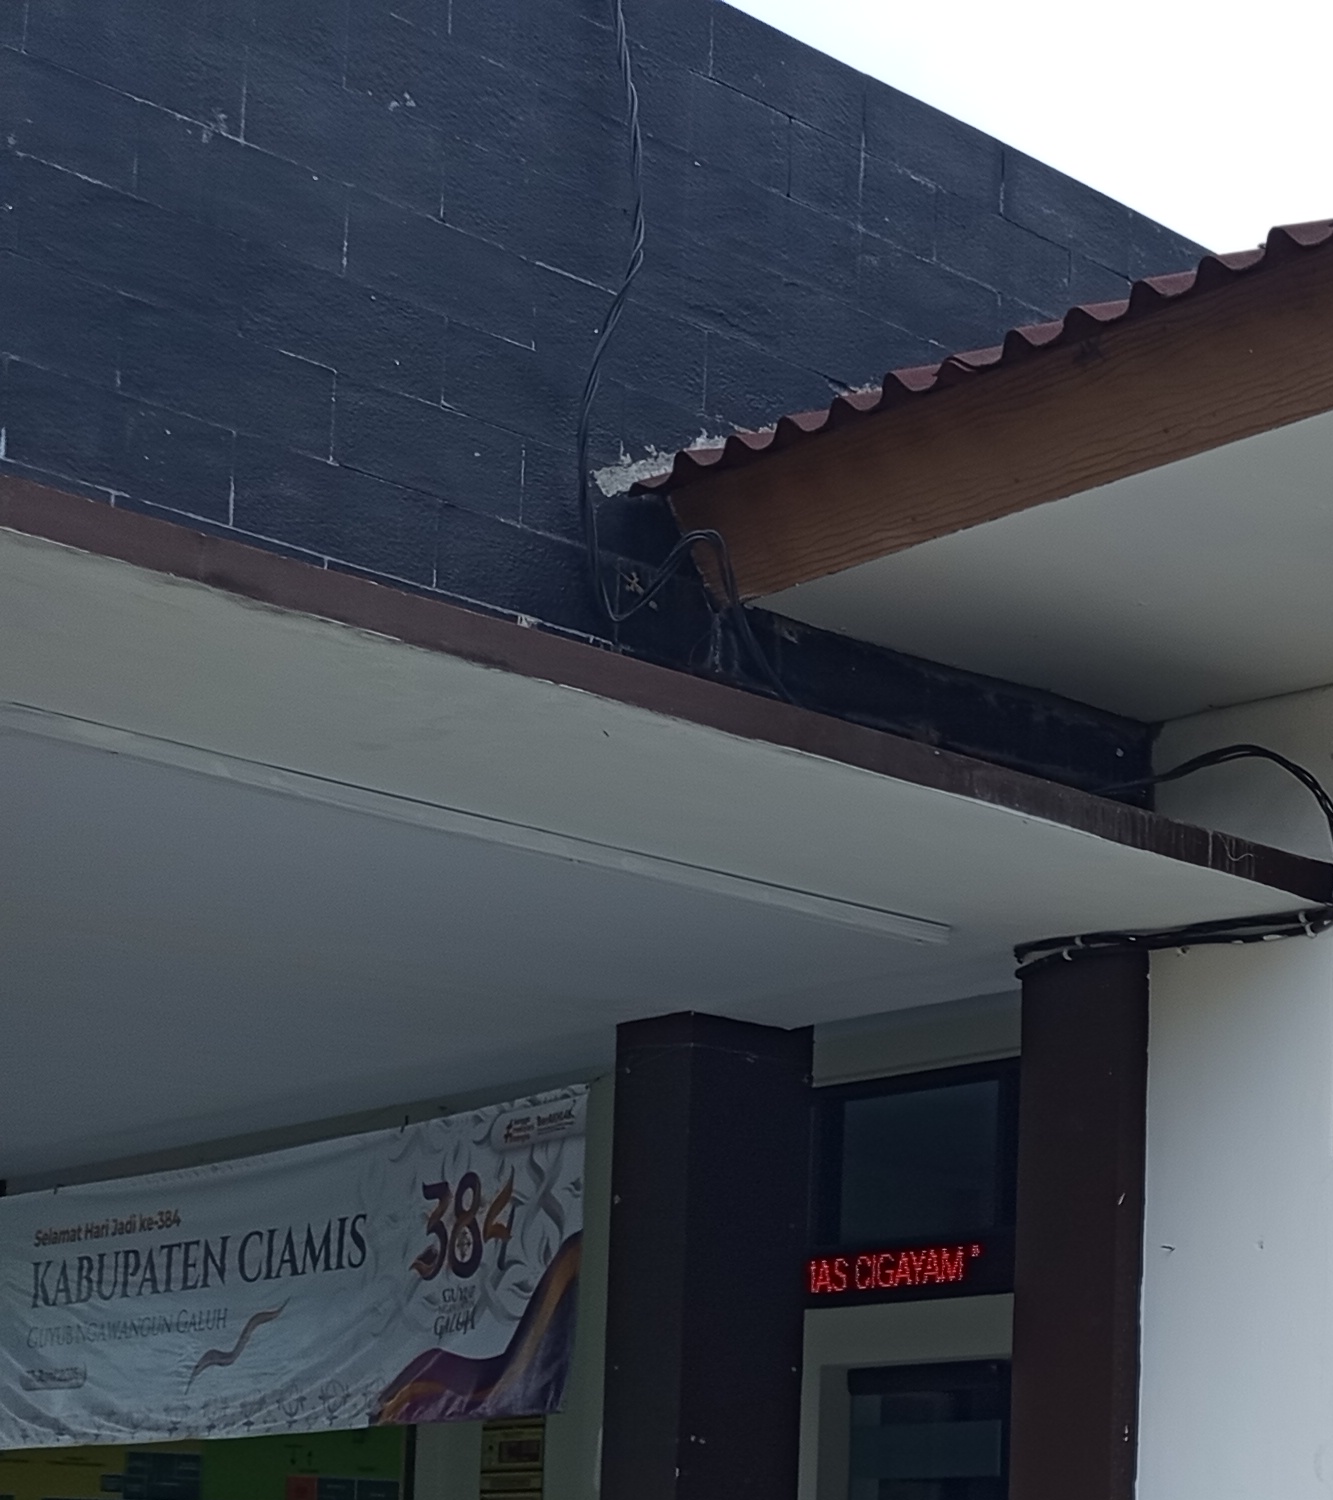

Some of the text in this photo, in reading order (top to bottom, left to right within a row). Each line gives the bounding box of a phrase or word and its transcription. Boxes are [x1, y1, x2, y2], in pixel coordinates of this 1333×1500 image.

[34, 1209, 182, 1247] Selamat Hari Jadi ke-384
[31, 1213, 368, 1309] KABUPATEN CIAMIS
[811, 1246, 964, 1293] AS CIGAYAM
[177, 1307, 229, 1334] GALUH
